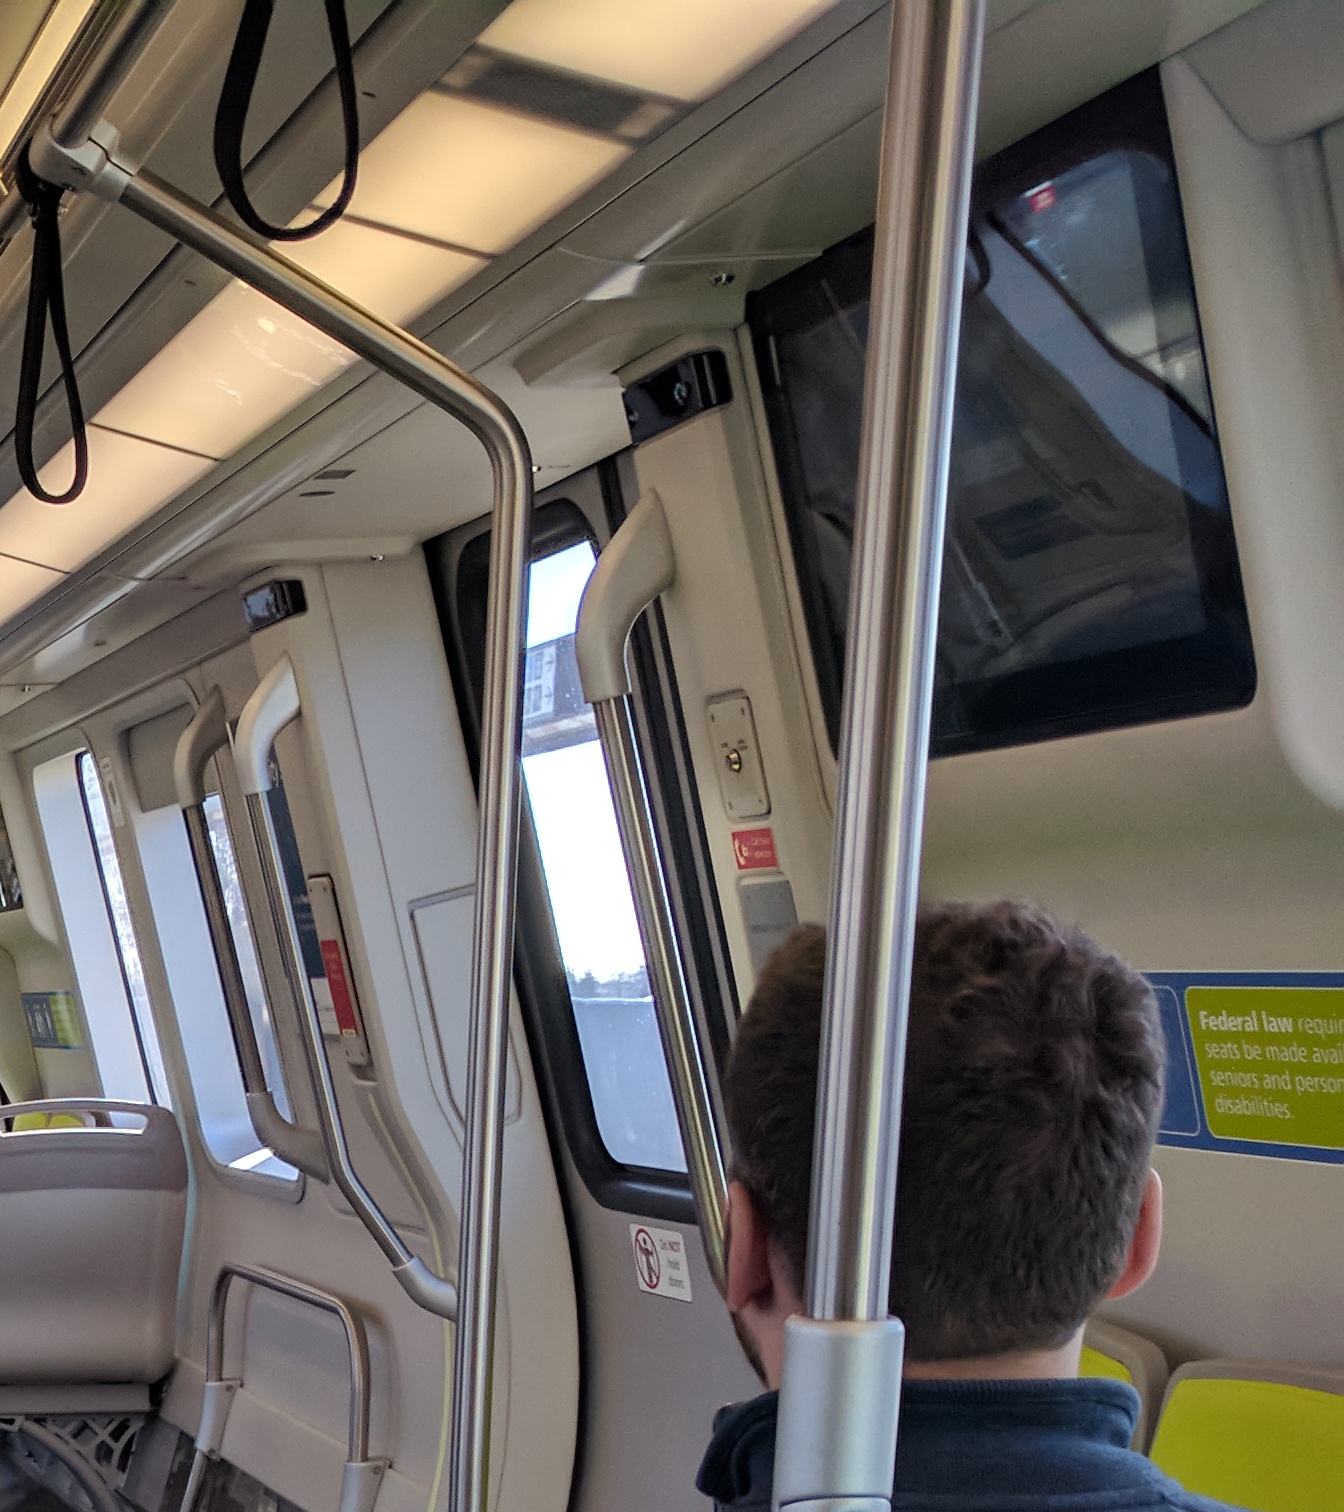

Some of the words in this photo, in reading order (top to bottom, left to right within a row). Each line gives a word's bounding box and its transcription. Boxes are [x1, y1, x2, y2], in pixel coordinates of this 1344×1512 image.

[1199, 1010, 1259, 1032] Federal
[1262, 1011, 1294, 1033] law
[1205, 1042, 1240, 1059] seats
[1242, 1040, 1262, 1060] be
[1266, 1042, 1308, 1063] made
[1210, 1067, 1260, 1089] seniors
[1263, 1071, 1292, 1090] and
